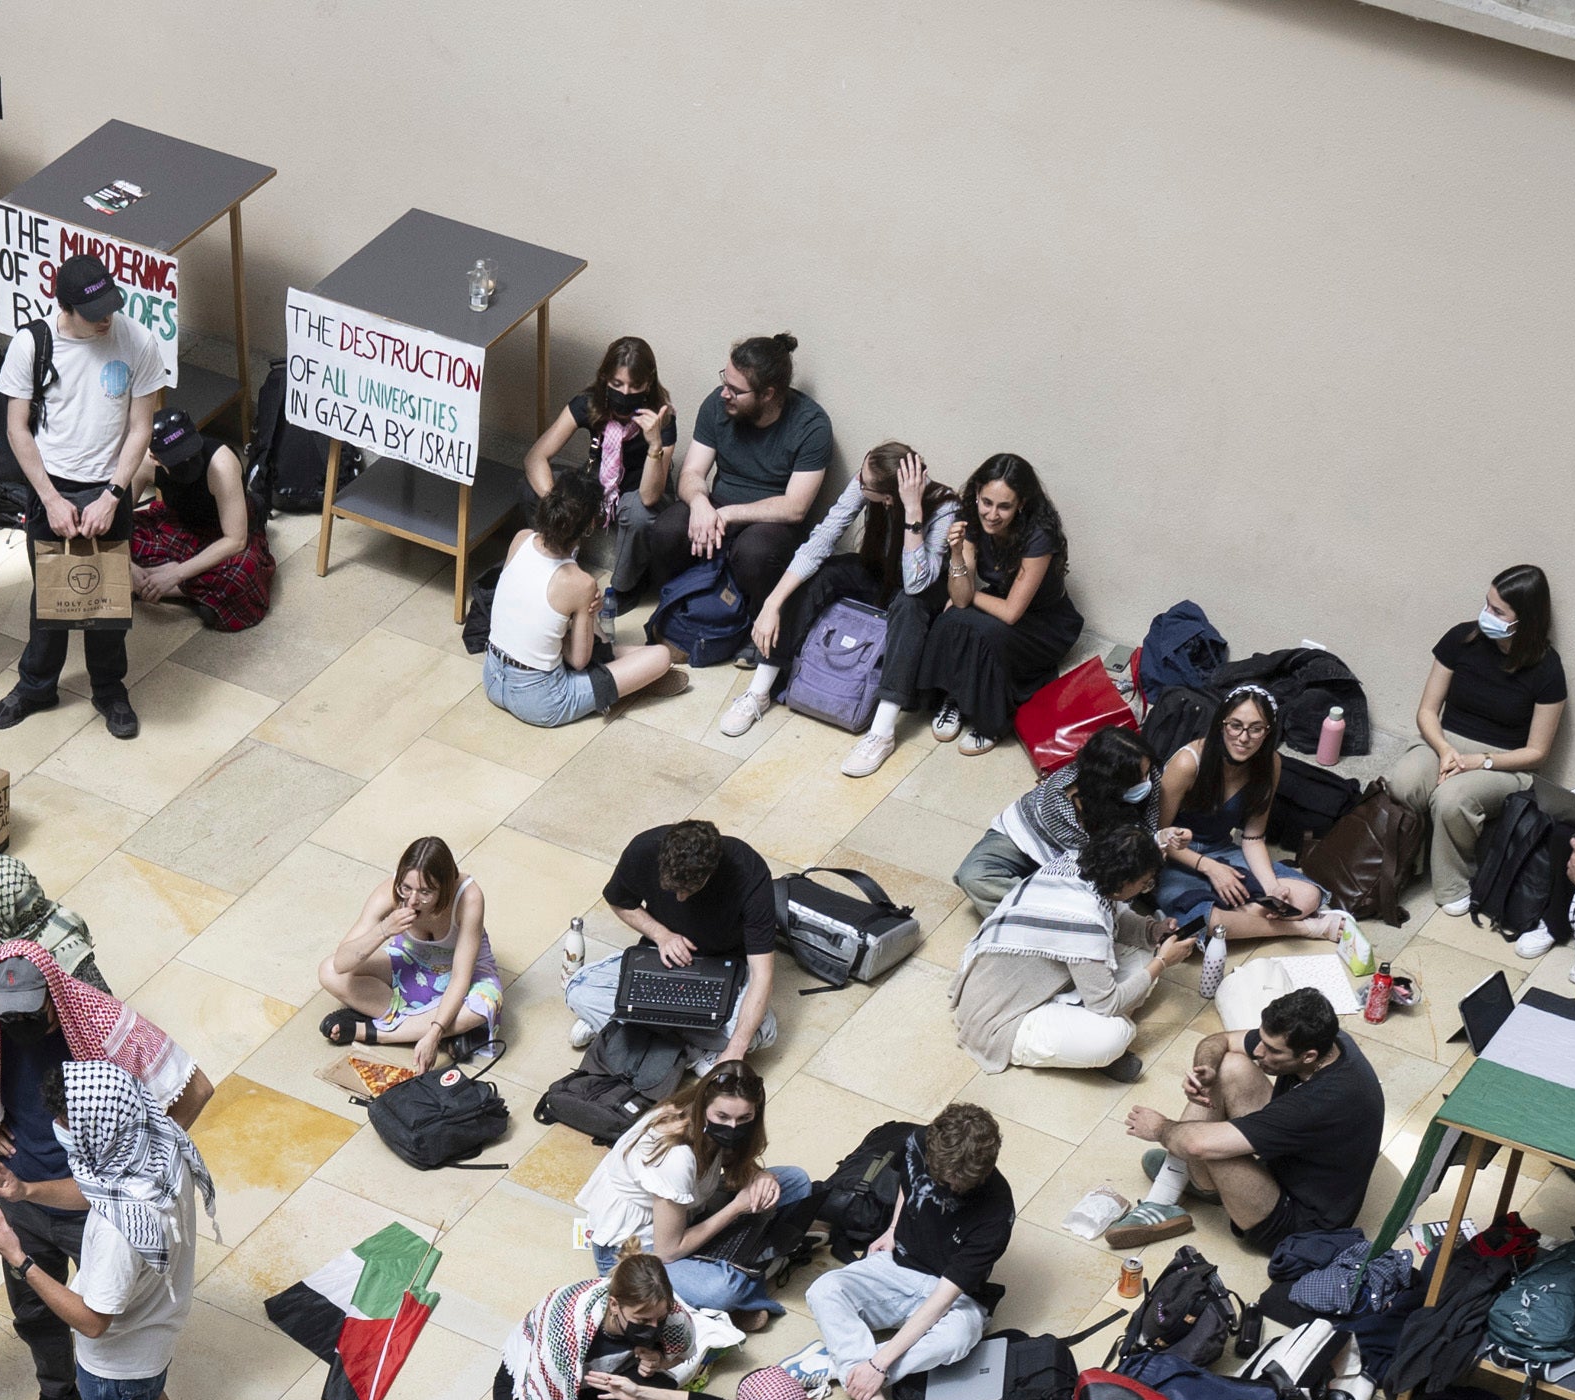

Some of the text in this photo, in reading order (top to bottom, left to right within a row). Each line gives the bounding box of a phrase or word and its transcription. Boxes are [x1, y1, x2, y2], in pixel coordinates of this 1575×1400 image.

[0, 248, 29, 286] OF
[39, 260, 58, 299] 9
[288, 305, 481, 392] THE DESTRUCTION
[290, 354, 458, 434] OF ALL UNIVERSITIES
[290, 388, 474, 478] IN GAZA BY ISRAEL
